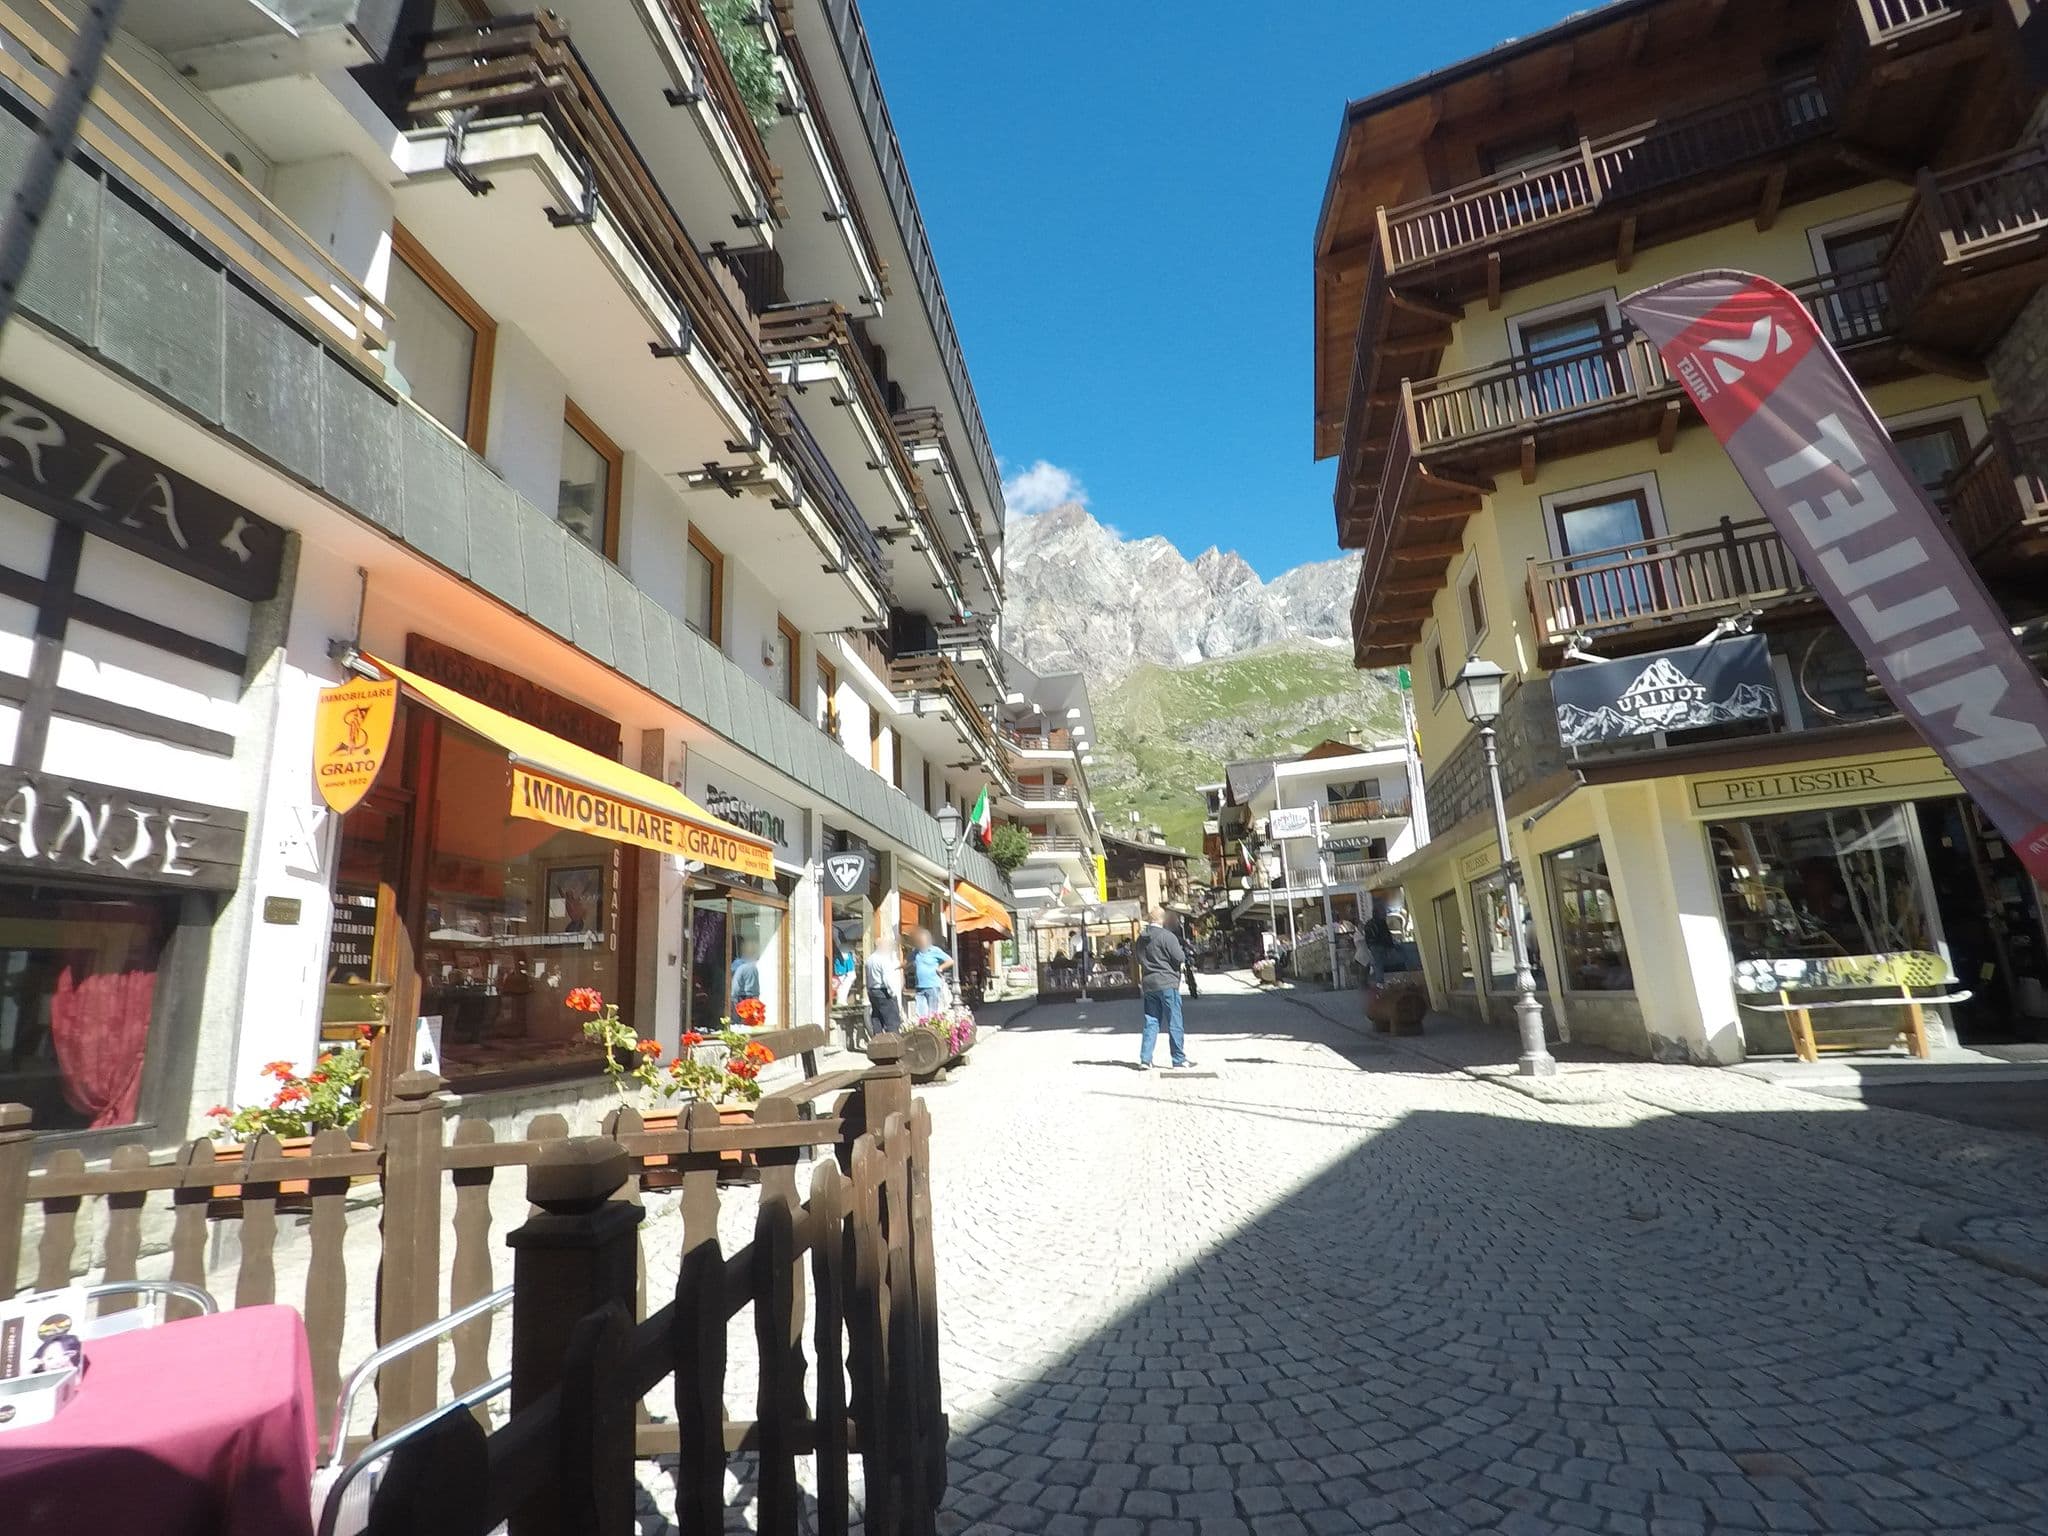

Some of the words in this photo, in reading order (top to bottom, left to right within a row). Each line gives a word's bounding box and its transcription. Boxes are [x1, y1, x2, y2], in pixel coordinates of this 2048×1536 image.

[321, 688, 393, 703] IMMOBILIARE
[1616, 687, 1706, 712] UAINOT
[321, 760, 375, 776] GRATO
[1726, 767, 1884, 800] PELLISSIER
[524, 777, 673, 845] IMMOBILIARE
[688, 830, 737, 862] GRATO
[610, 848, 620, 951] GRATO
